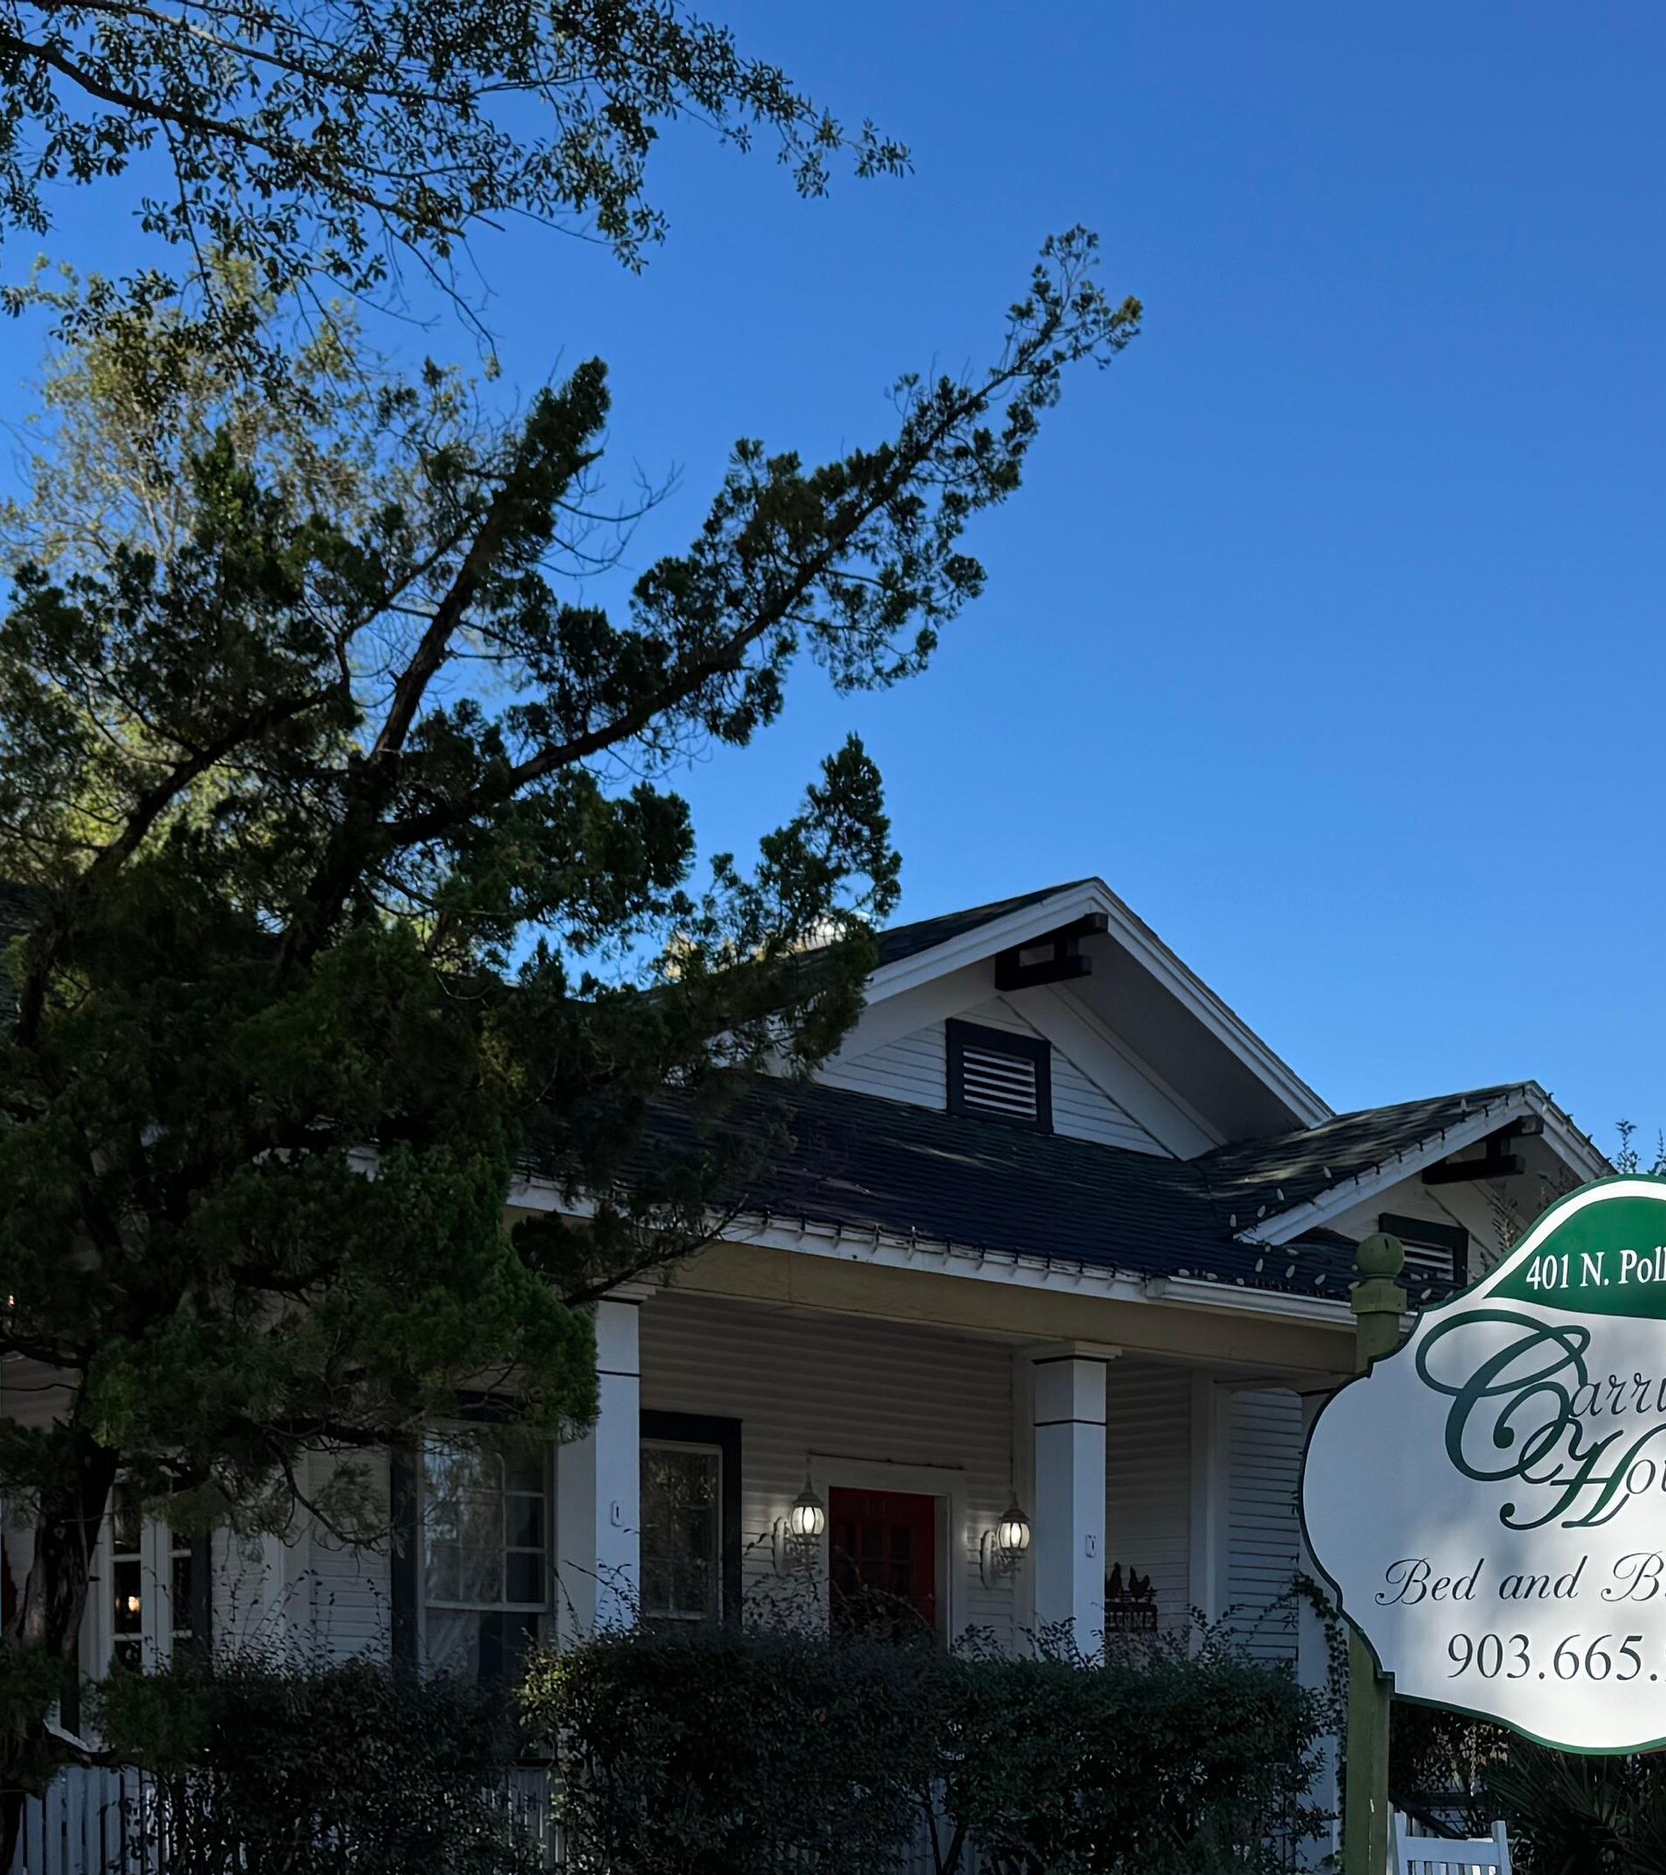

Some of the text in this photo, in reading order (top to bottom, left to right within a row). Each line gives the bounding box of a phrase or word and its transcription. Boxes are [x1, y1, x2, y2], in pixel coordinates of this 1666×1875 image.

[1525, 1253, 1570, 1291] 401
[1579, 1251, 1610, 1288] N.
[1374, 1556, 1486, 1607] Bed
[1498, 1555, 1589, 1600] and
[1105, 1611, 1154, 1628] LCOME
